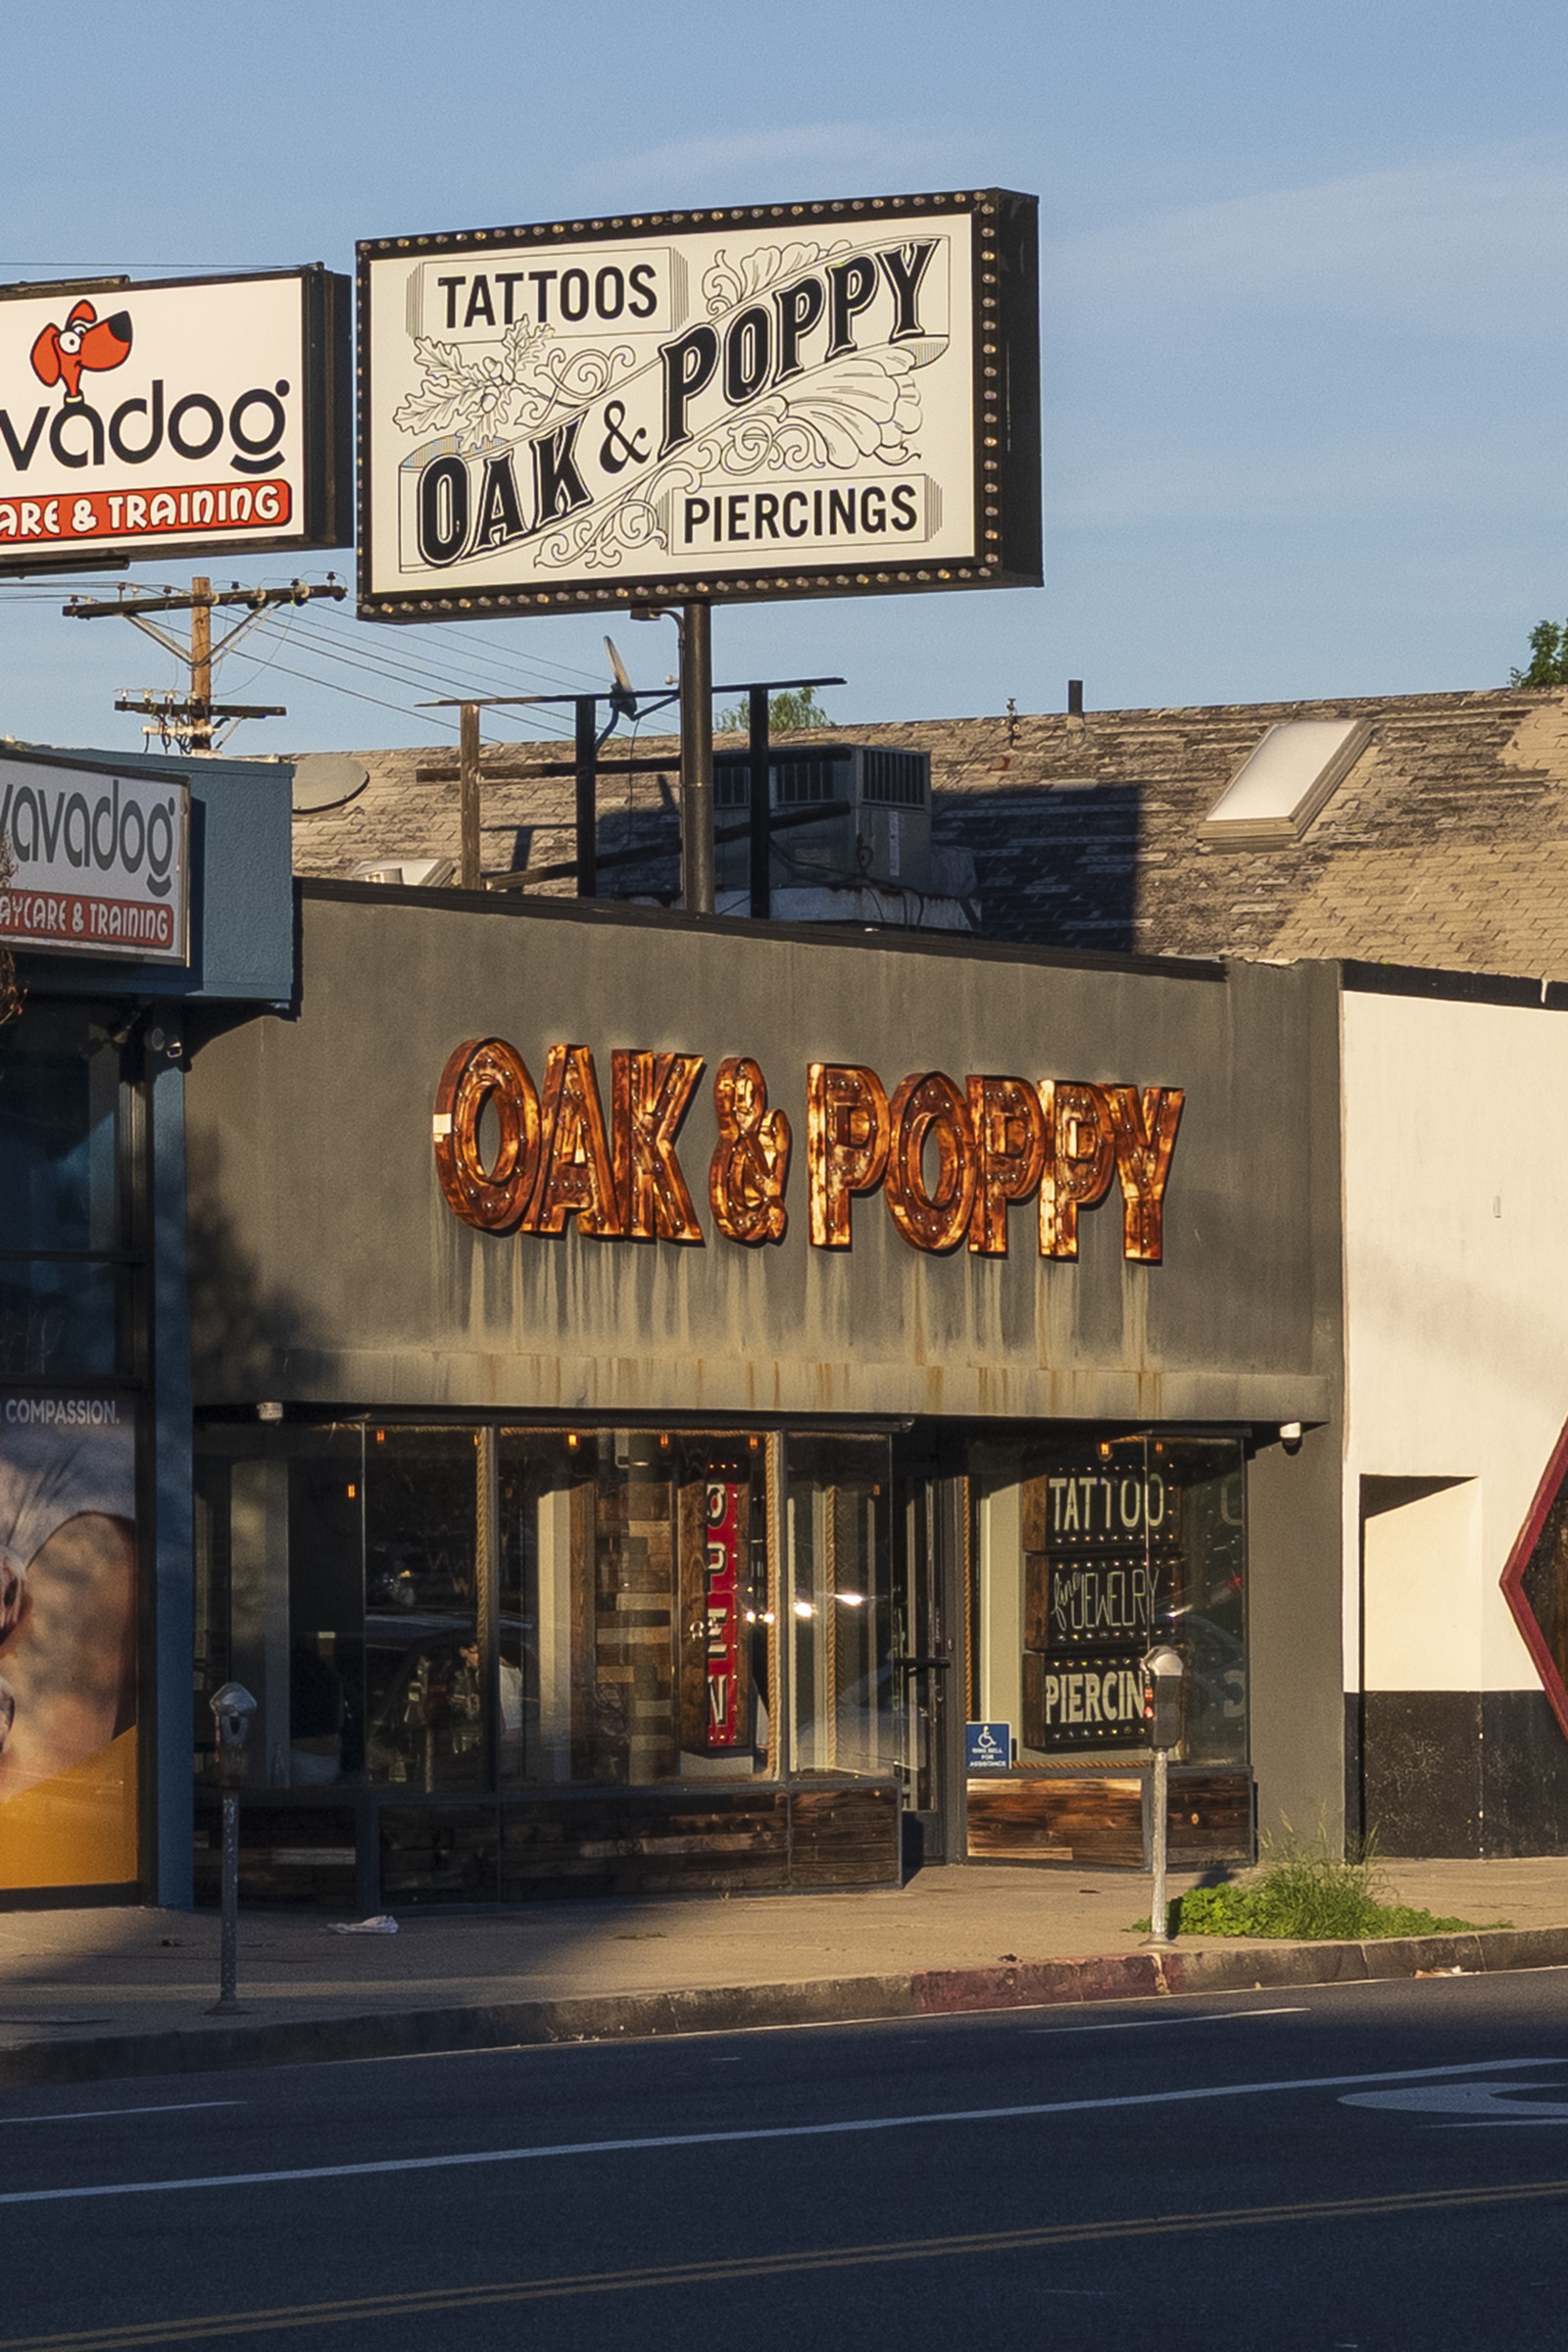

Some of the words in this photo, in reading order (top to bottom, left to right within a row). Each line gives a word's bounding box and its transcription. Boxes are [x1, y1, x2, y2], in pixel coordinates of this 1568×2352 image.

[437, 263, 659, 329] TATTOOS
[416, 409, 594, 568] OAK
[599, 400, 652, 474] &
[659, 237, 942, 463] POPPY
[72, 498, 97, 532] &
[109, 484, 280, 529] TRAINING
[683, 484, 919, 544] PIERCINGS
[72, 901, 84, 933] &
[89, 903, 169, 943] TRAINING
[432, 1035, 707, 1247] OAK
[710, 1055, 789, 1244] &
[806, 1061, 1186, 1263] POPPY
[5, 1398, 120, 1424] COMPASSION.
[1049, 1473, 1164, 1532] TATTOO
[1045, 1670, 1146, 1725] PIERCIN
